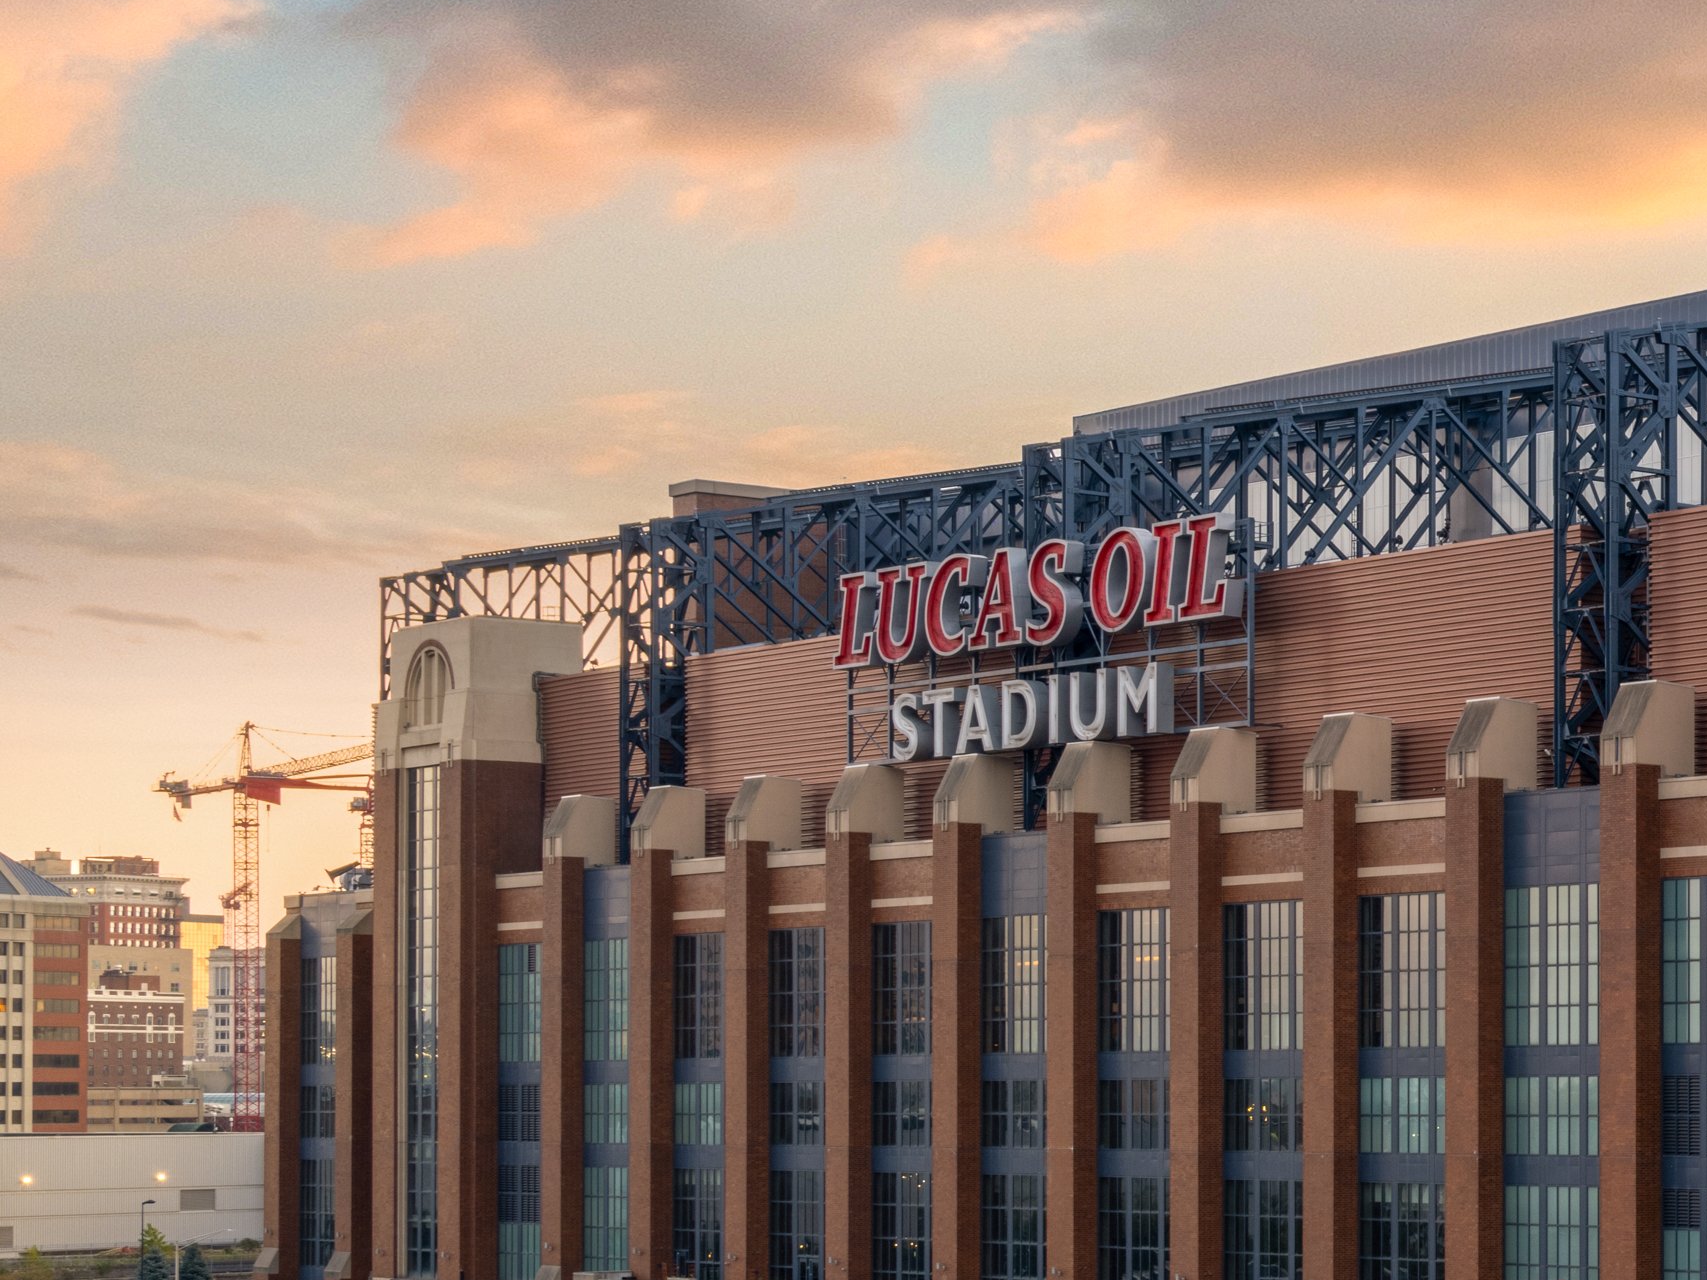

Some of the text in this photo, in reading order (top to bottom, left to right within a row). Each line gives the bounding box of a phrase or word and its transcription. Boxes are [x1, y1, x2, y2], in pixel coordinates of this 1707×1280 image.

[833, 512, 1241, 670] LUCAS OIL
[892, 661, 1174, 762] STADIUM
